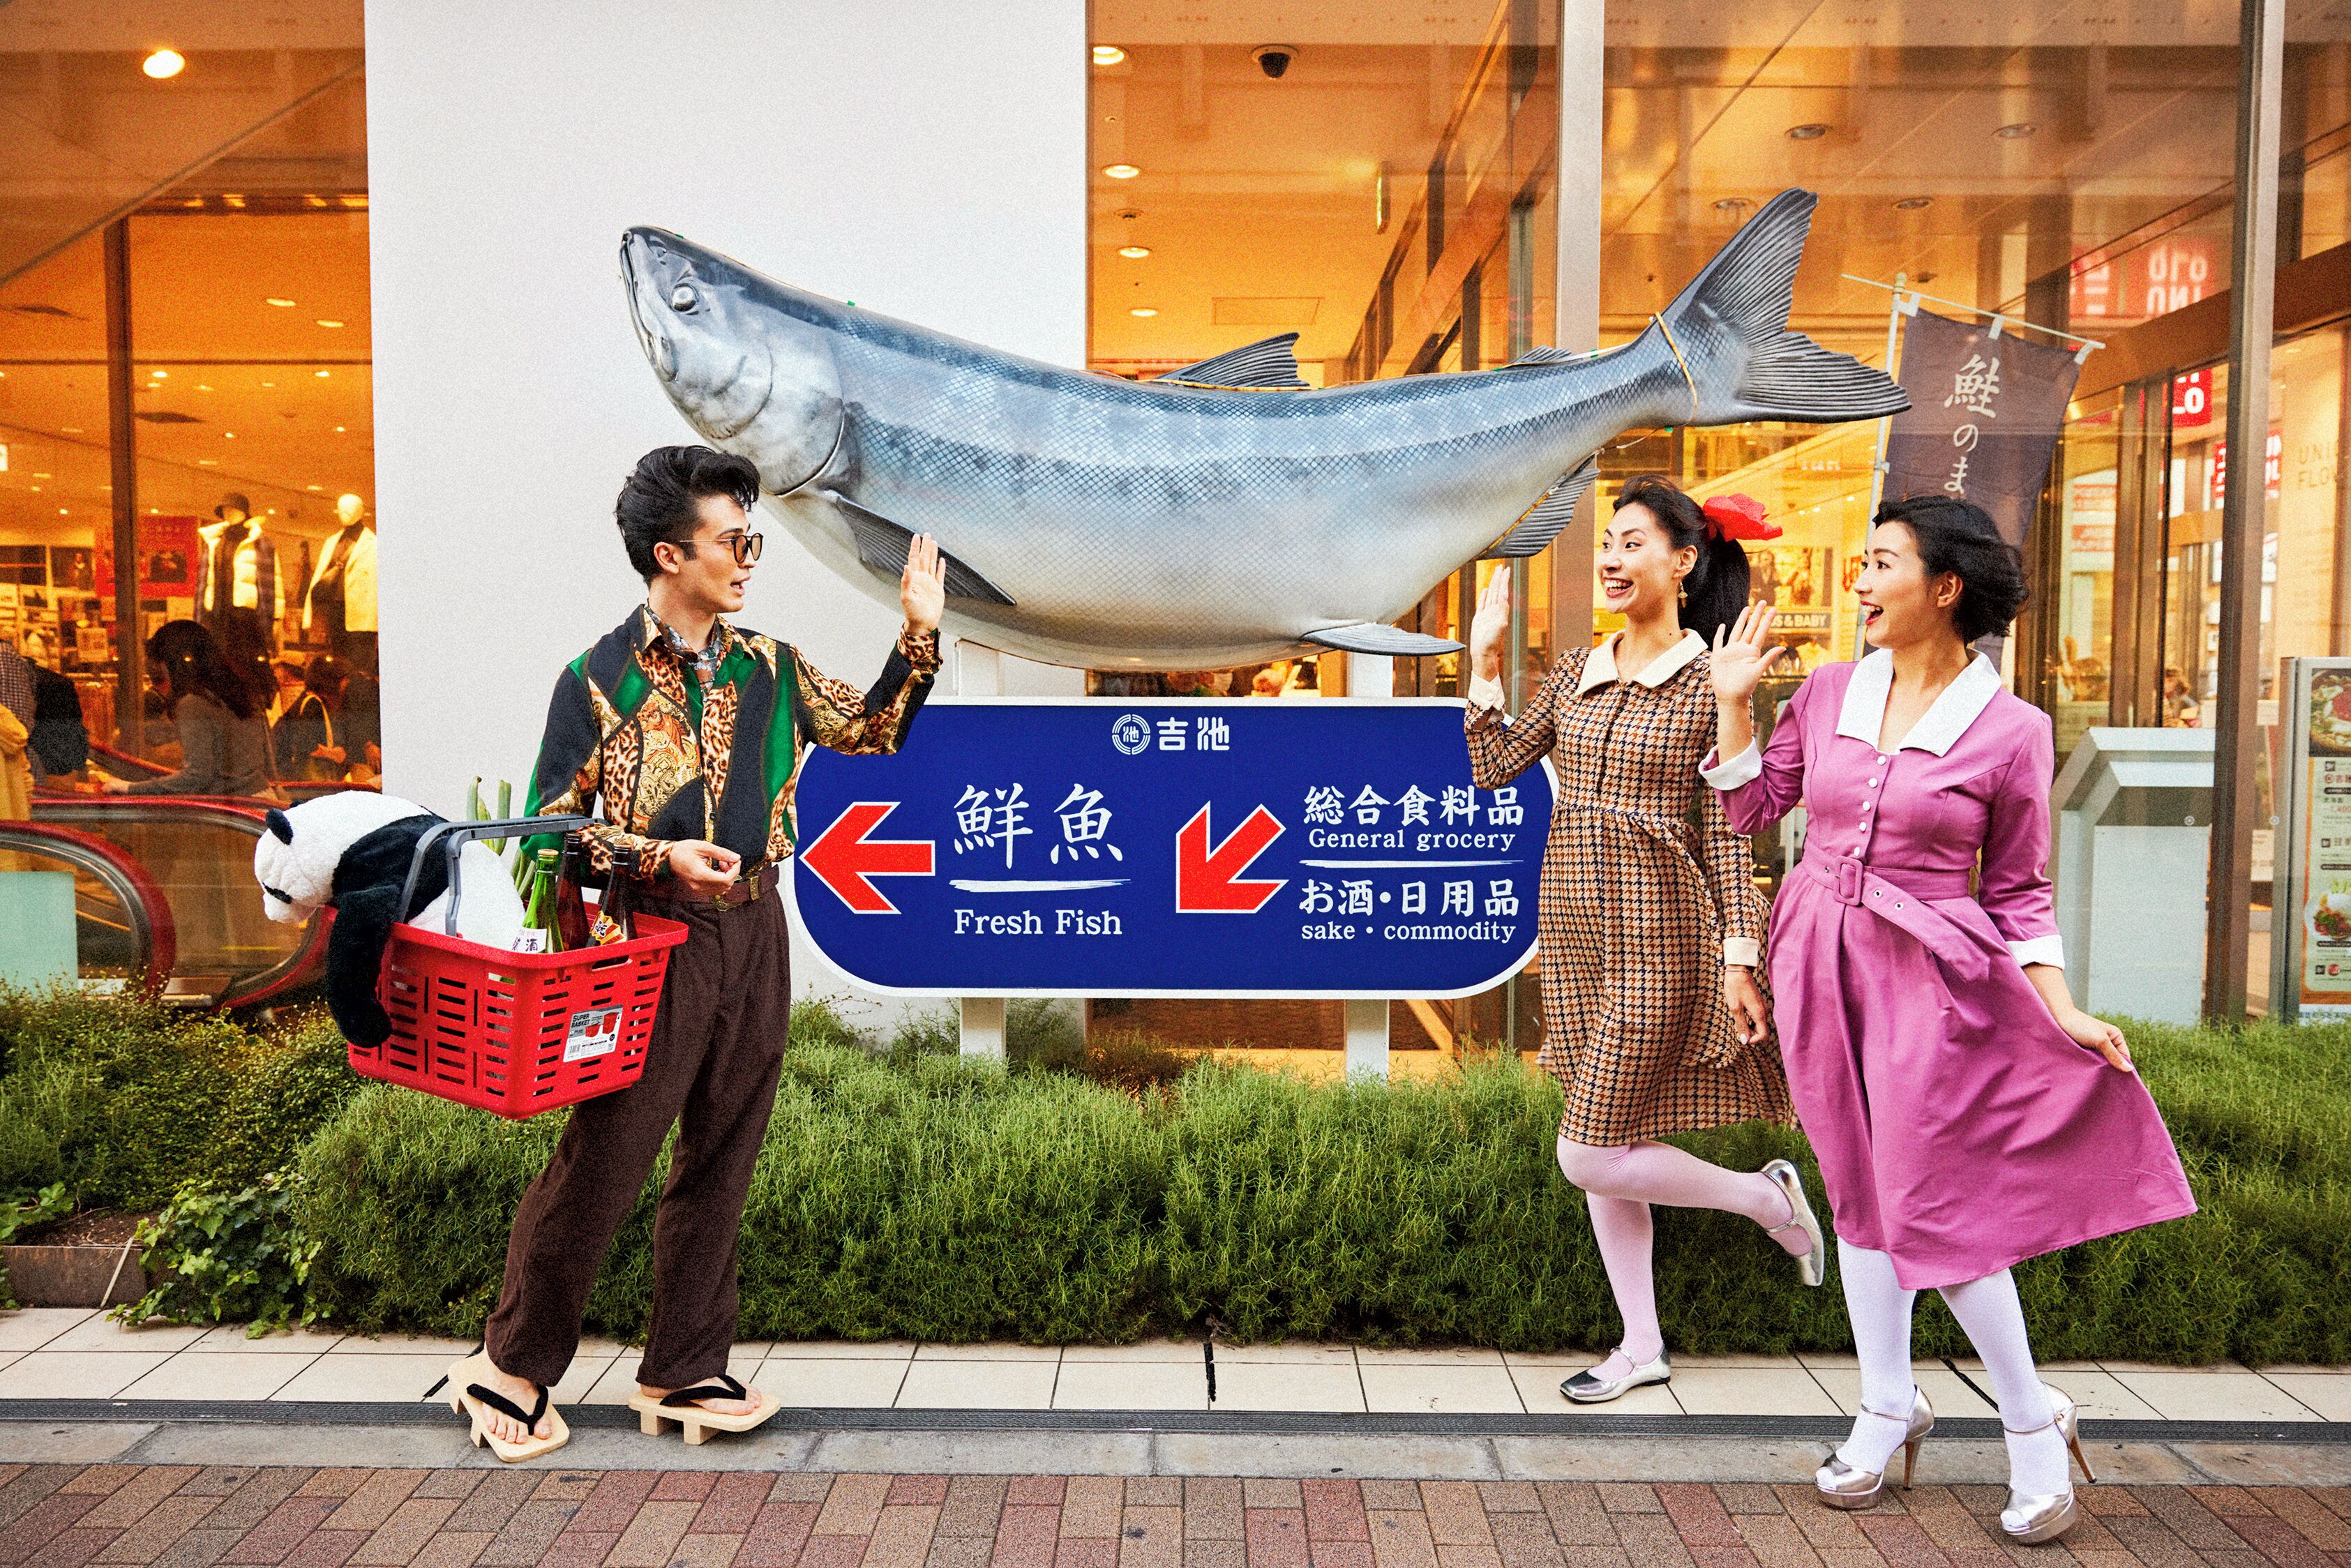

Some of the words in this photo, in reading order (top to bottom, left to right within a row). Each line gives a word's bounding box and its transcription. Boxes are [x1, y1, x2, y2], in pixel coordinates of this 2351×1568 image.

[1794, 614, 1827, 628] BABY
[1156, 716, 1230, 751] 吉池
[1303, 784, 1525, 827] 総合食料品
[953, 783, 1124, 870] 鮮魚
[1308, 828, 1405, 849] General
[1416, 832, 1516, 852] grocery
[1298, 878, 1520, 918] お酒・日用品
[954, 909, 1043, 935] Fresh
[1056, 909, 1122, 935] Fish
[1301, 921, 1355, 940] sake
[1383, 921, 1517, 944] commodity
[571, 1019, 591, 1028] BASKET
[572, 1013, 589, 1023] SUPER
